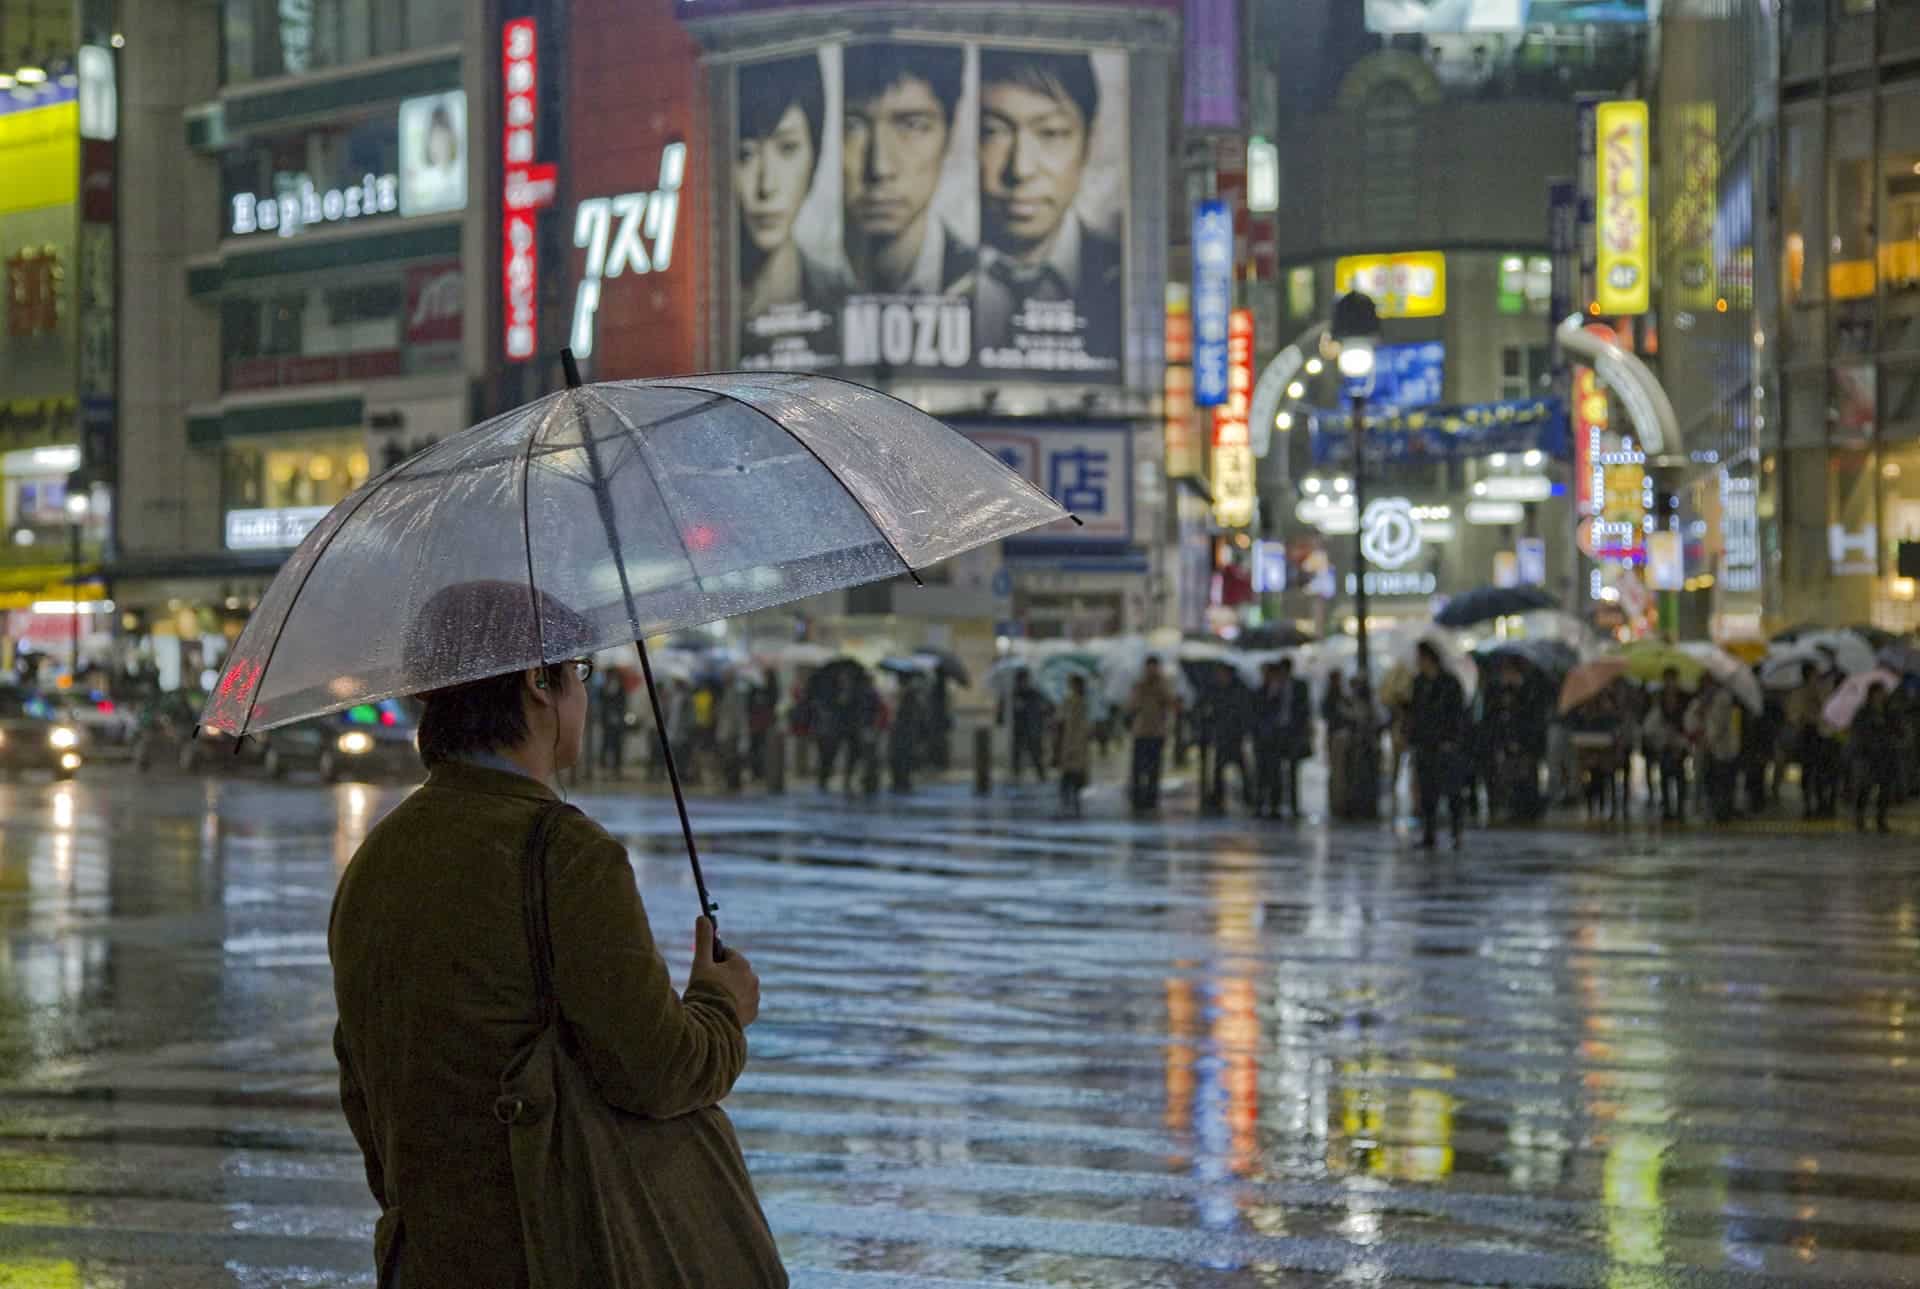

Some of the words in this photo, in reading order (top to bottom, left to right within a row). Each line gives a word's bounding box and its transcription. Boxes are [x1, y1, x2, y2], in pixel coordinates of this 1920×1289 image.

[232, 173, 398, 238] Euphoria
[570, 142, 686, 359] クスリ
[843, 303, 971, 367] MOZU
